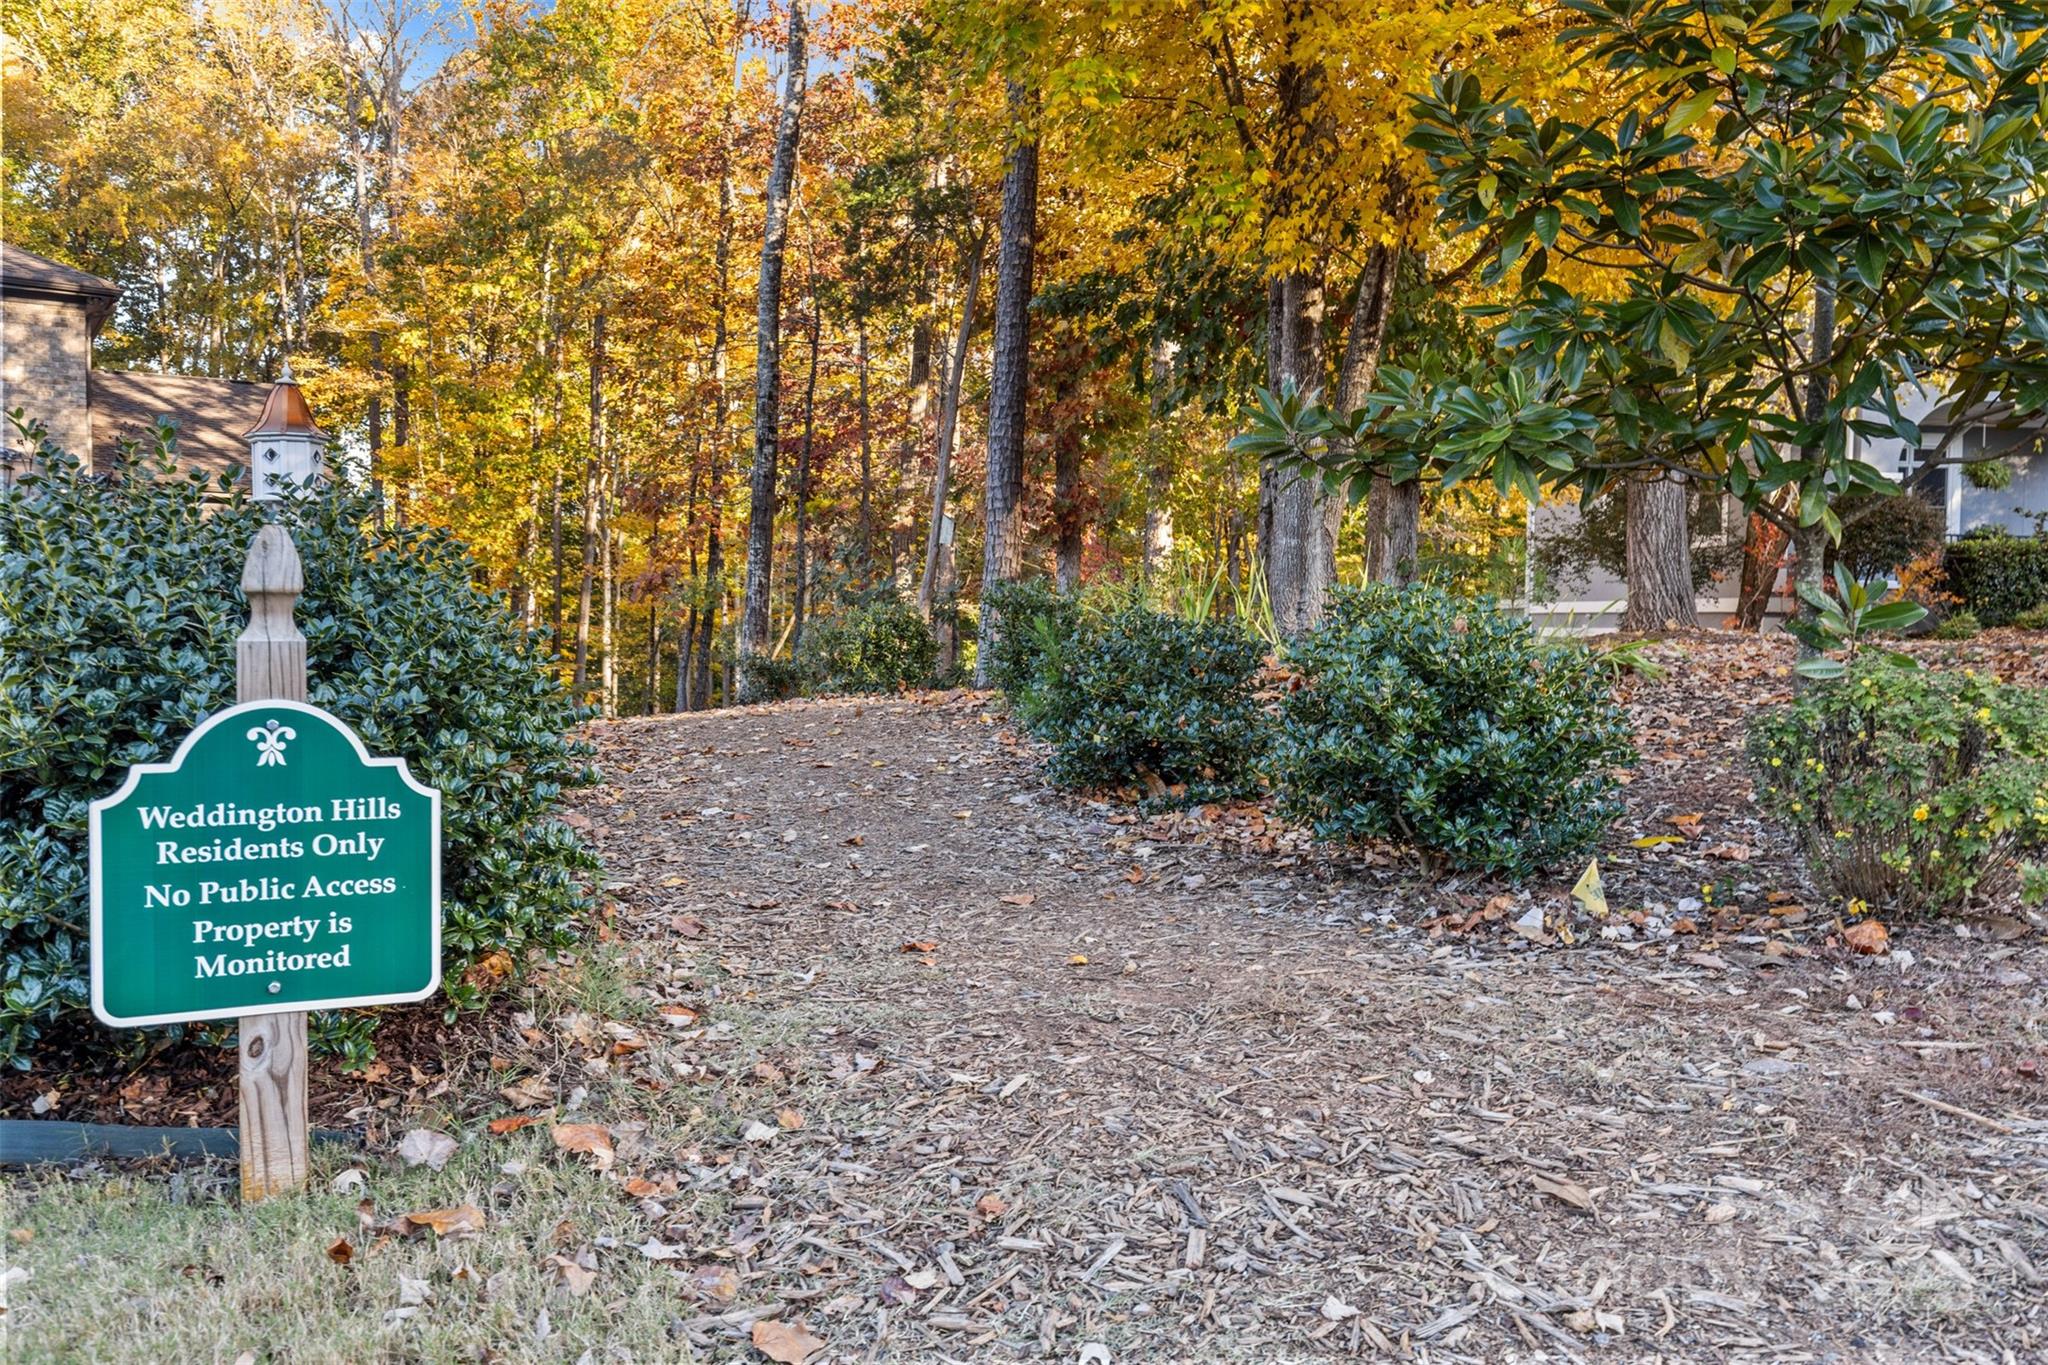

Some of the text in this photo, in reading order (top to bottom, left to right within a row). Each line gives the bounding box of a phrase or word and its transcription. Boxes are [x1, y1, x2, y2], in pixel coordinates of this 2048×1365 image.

[137, 797, 402, 832] Weddington Hills
[156, 832, 385, 864] Residents Only
[144, 876, 396, 908] No Public Access
[192, 912, 352, 947] Property is
[195, 944, 351, 979] Monitored
